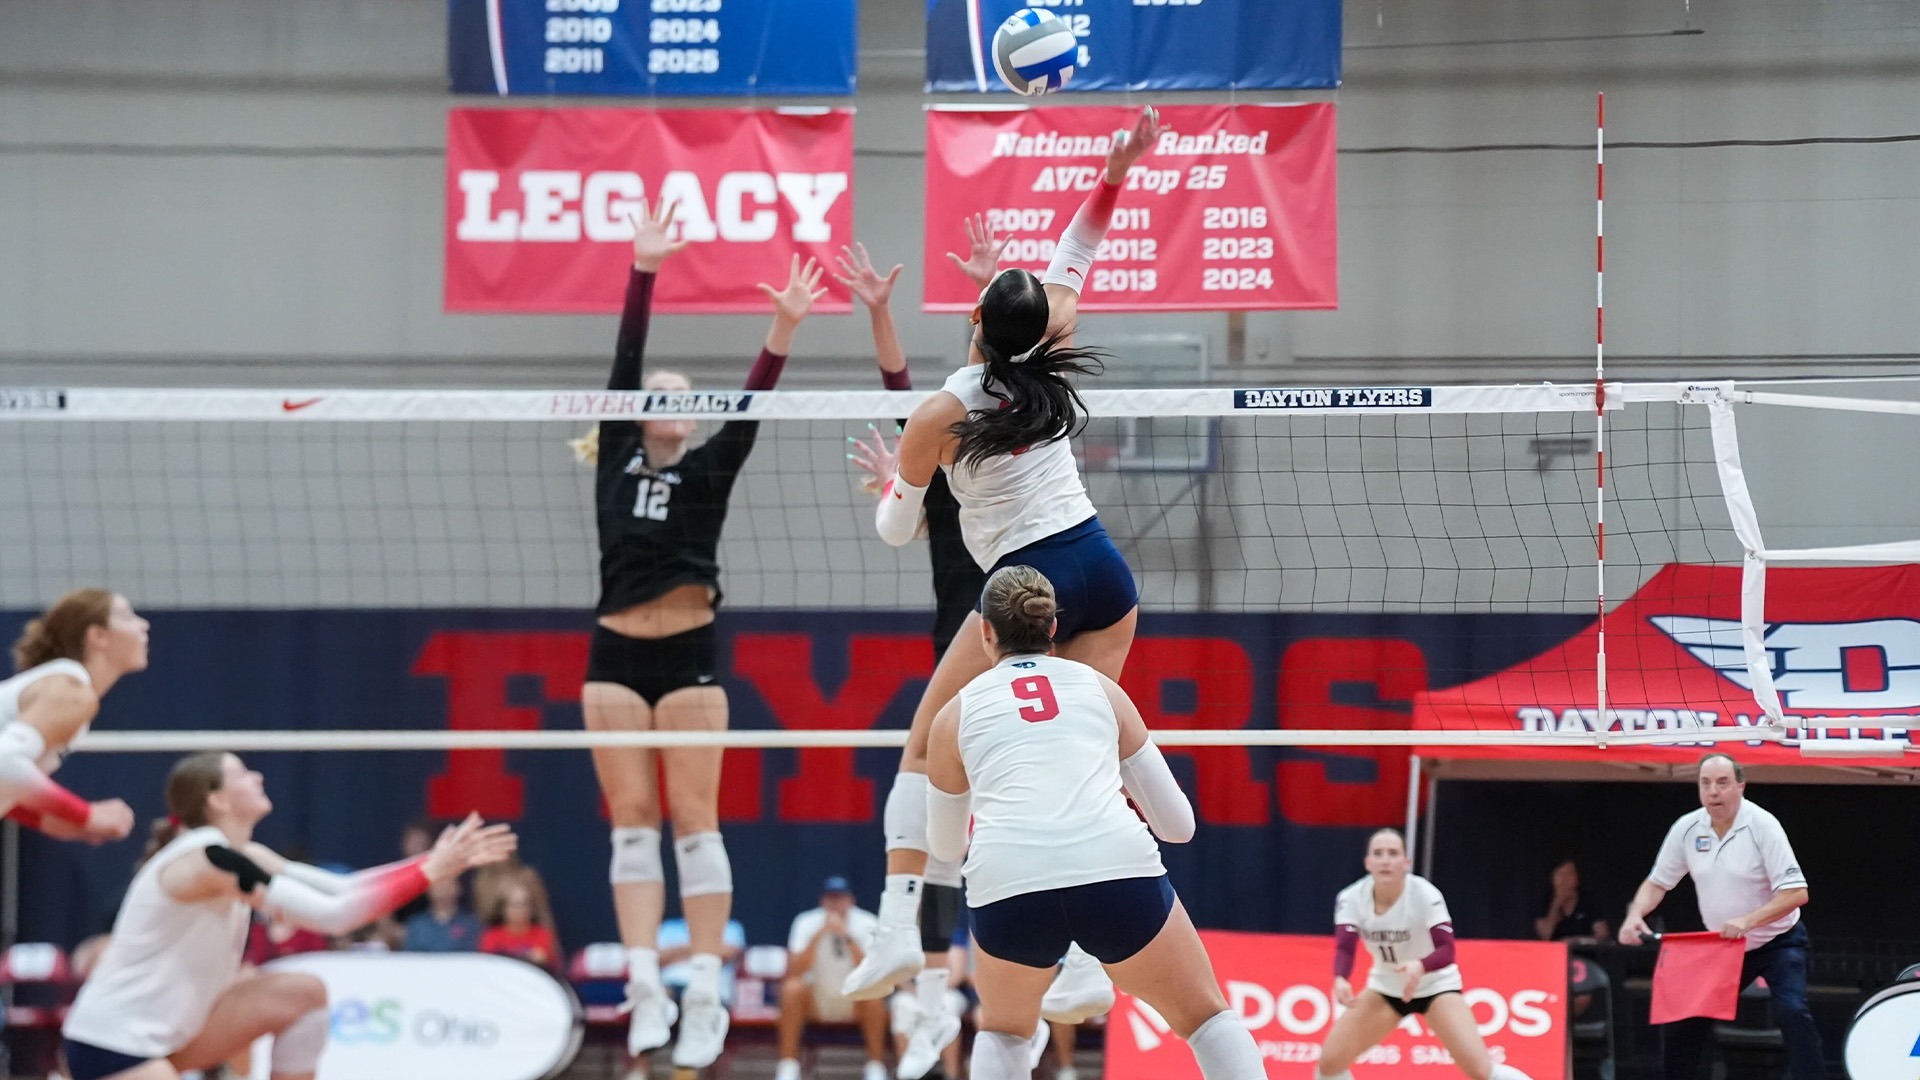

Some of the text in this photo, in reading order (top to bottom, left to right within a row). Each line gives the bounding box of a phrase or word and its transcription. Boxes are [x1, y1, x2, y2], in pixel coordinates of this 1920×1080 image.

[544, 16, 613, 43] 2010
[649, 18, 721, 44] 2024
[544, 47, 603, 73] 2011
[648, 48, 719, 74] 2025
[1155, 130, 1268, 156] Ranked
[1031, 164, 1228, 195] AVC Top 25
[457, 169, 848, 243] LEGACY
[1203, 207, 1267, 230] 2016
[985, 208, 1055, 231] 2007
[1110, 208, 1151, 231] 011
[1094, 238, 1158, 262] 2012
[1203, 237, 1274, 261] 2023
[1092, 268, 1158, 292] 2013
[1203, 267, 1274, 291] 2024
[648, 394, 743, 413] LEGACY
[1244, 389, 1423, 408] DAYTON FLYERS
[632, 478, 672, 521] 12
[1010, 675, 1060, 723] 9
[409, 631, 1428, 828] FYRS
[1378, 945, 1398, 964] 11
[1226, 980, 1551, 1038] DOOS
